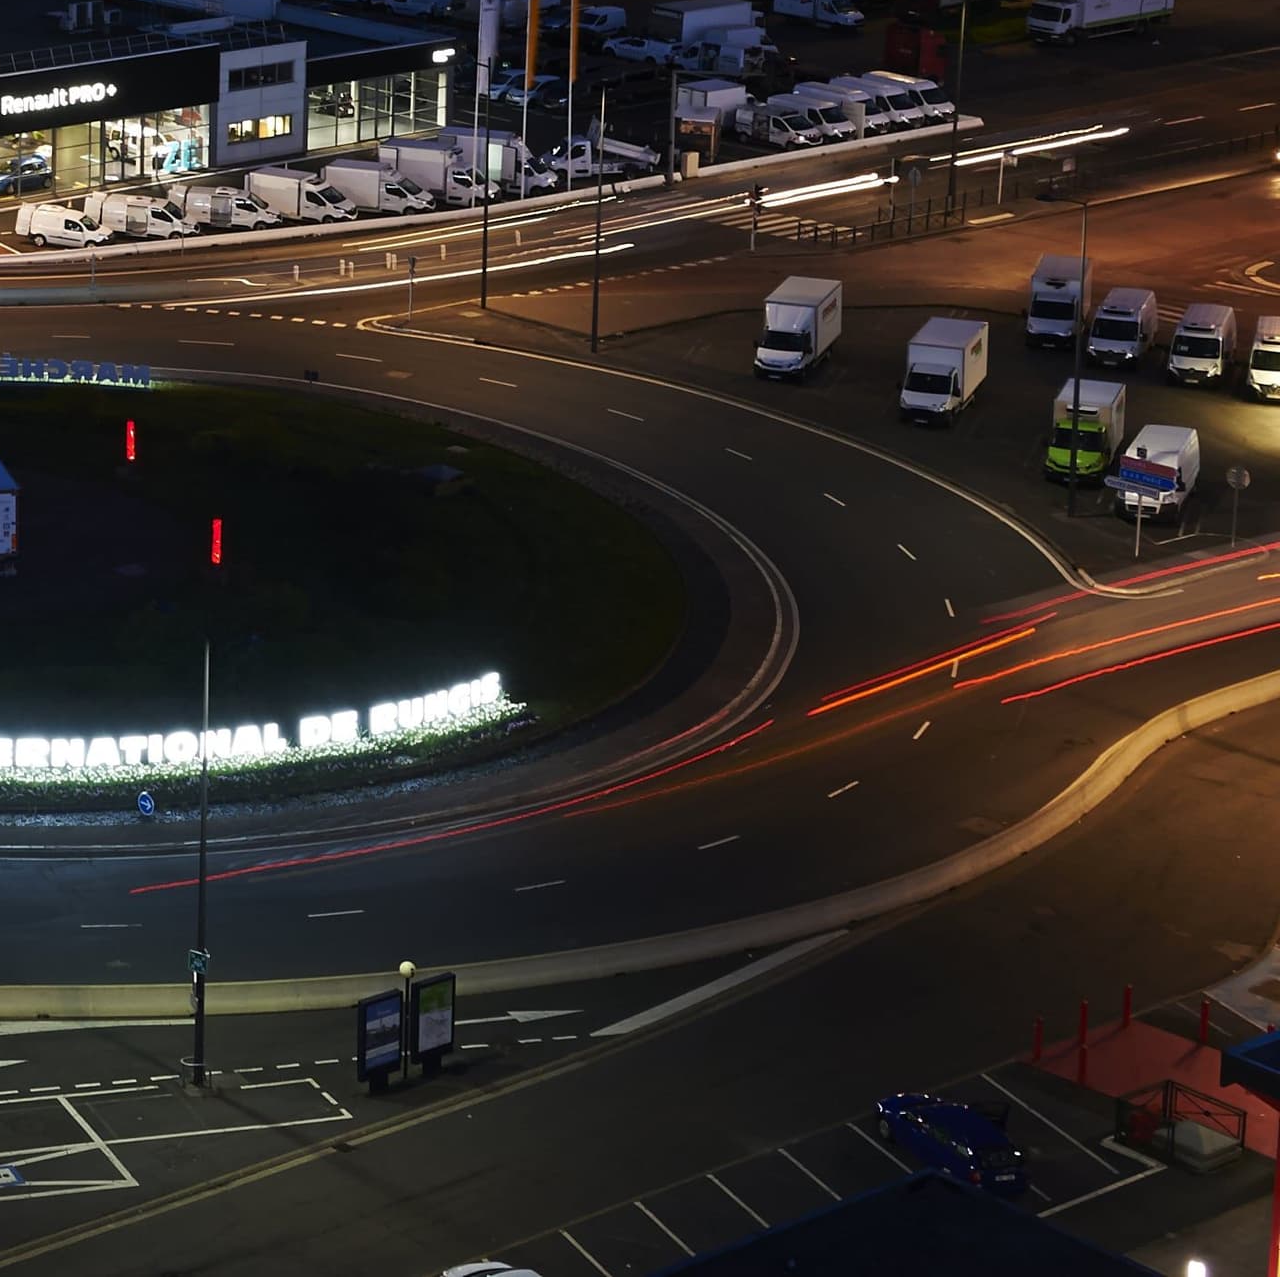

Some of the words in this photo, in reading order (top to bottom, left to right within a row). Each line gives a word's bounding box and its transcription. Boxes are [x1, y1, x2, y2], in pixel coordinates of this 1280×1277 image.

[0, 87, 68, 116] Renault
[69, 82, 118, 106] PRO+
[299, 709, 360, 747] DE
[370, 672, 502, 735] RUNGIS
